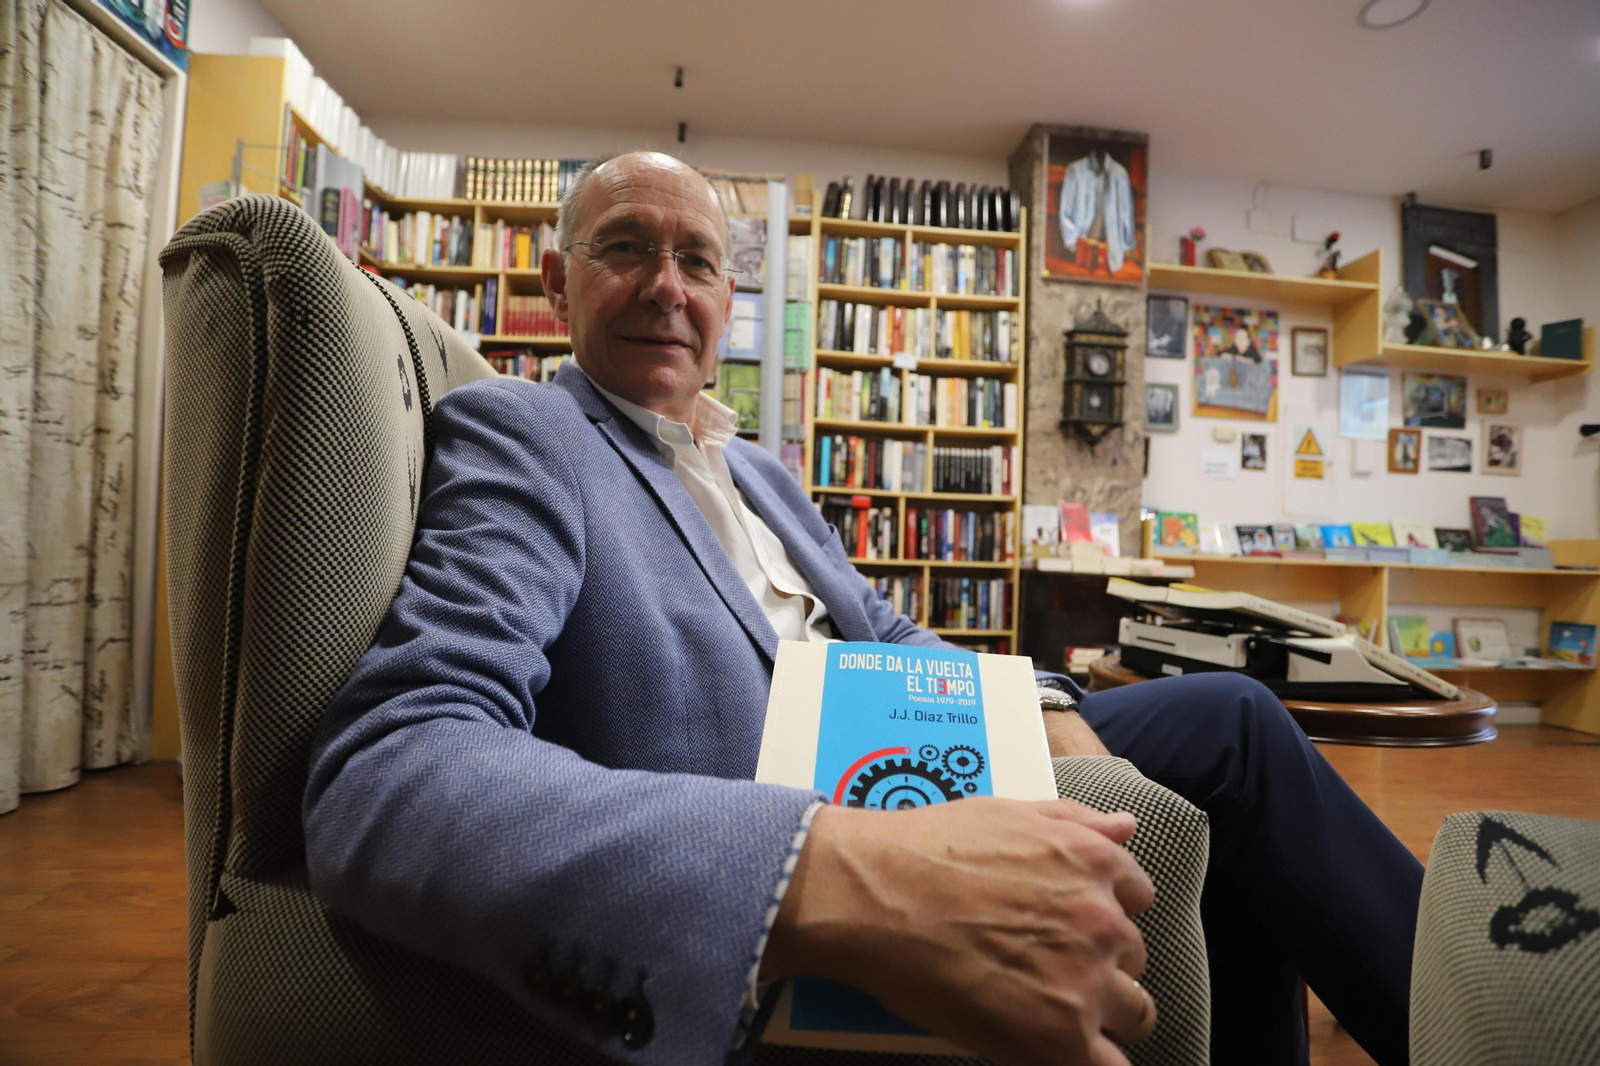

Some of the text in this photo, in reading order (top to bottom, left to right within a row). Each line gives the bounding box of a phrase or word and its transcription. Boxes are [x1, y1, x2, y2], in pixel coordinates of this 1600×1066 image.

[839, 653, 974, 679] DONDE DA LA VUELTA
[906, 675, 923, 693] EL
[936, 696, 976, 706] 1979-2019
[888, 708, 978, 725] J.J. Díaz Trillo
